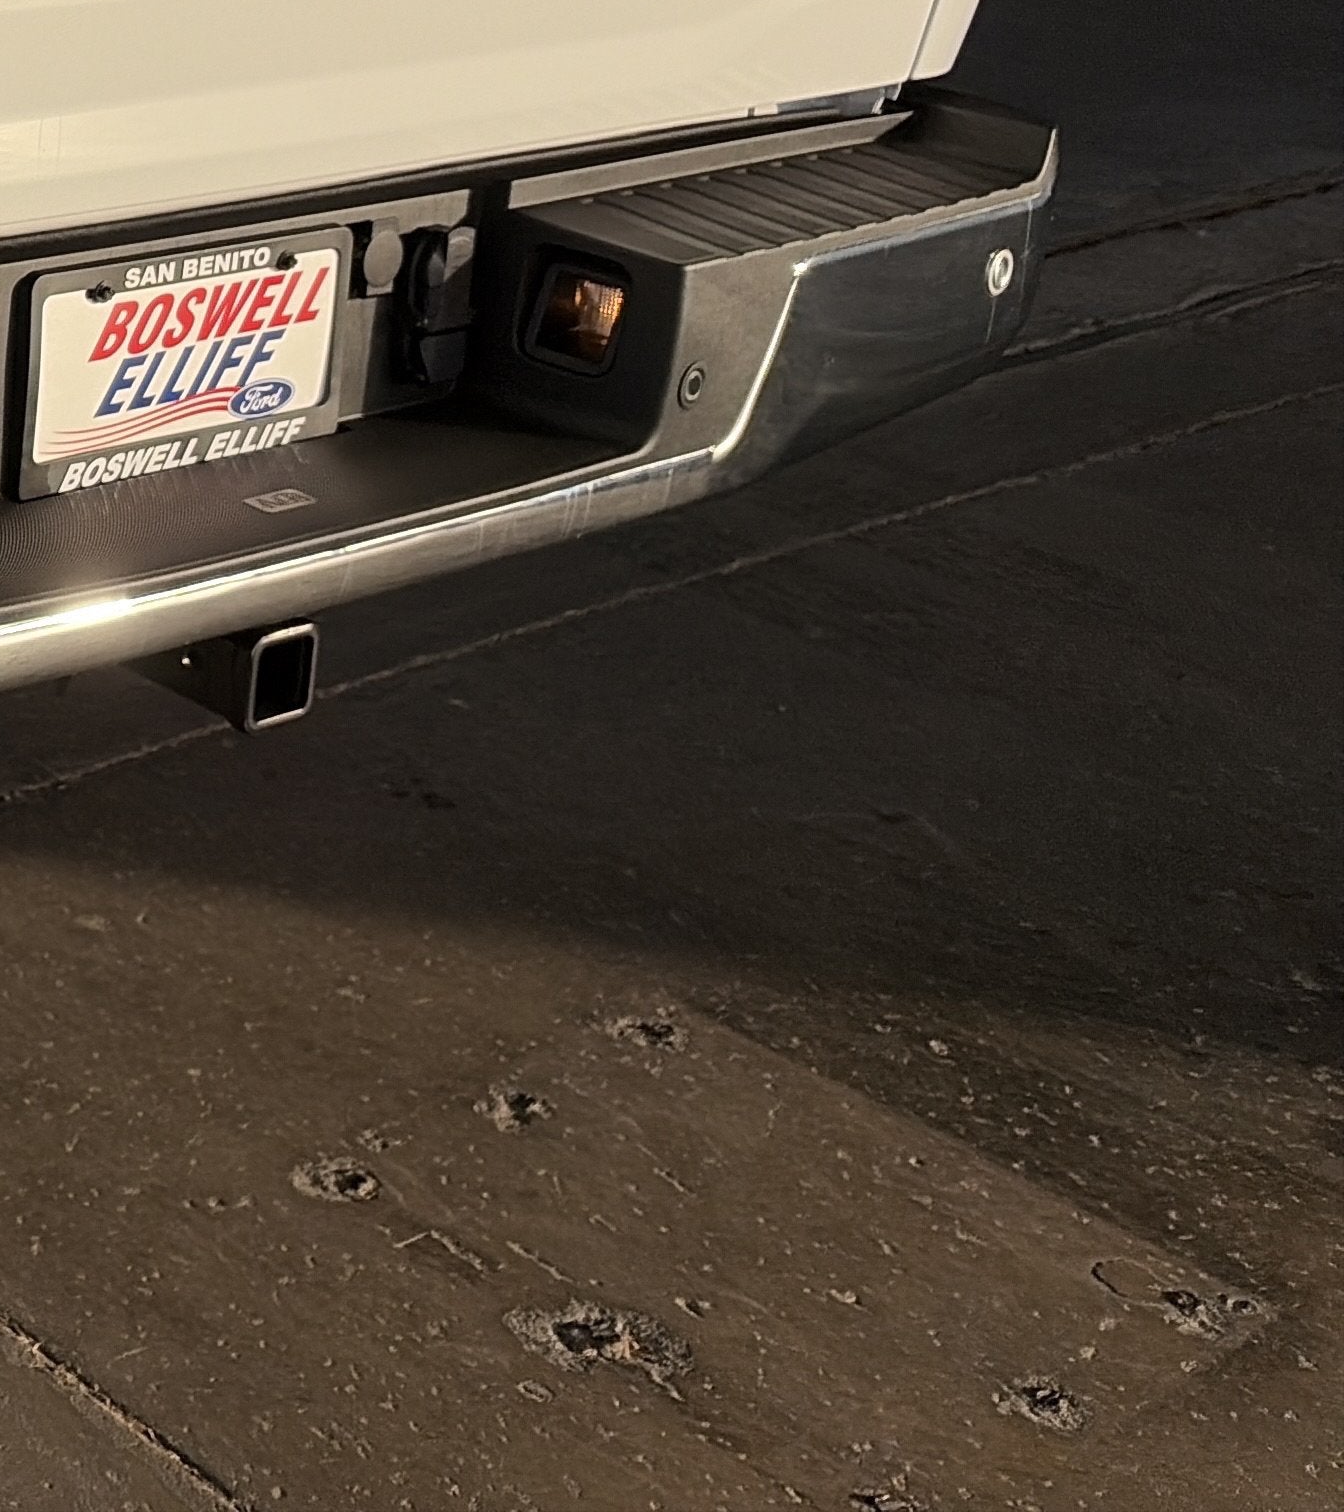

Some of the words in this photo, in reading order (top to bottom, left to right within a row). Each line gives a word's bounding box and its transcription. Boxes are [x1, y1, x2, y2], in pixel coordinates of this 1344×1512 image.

[124, 261, 178, 289] SAN
[182, 246, 271, 279] BENITO
[87, 267, 330, 362] BOSWELL
[93, 328, 287, 418] ELLIFF
[239, 384, 283, 414] Ford
[58, 437, 200, 493] BOSWELL
[204, 416, 307, 462] ELLIFF
